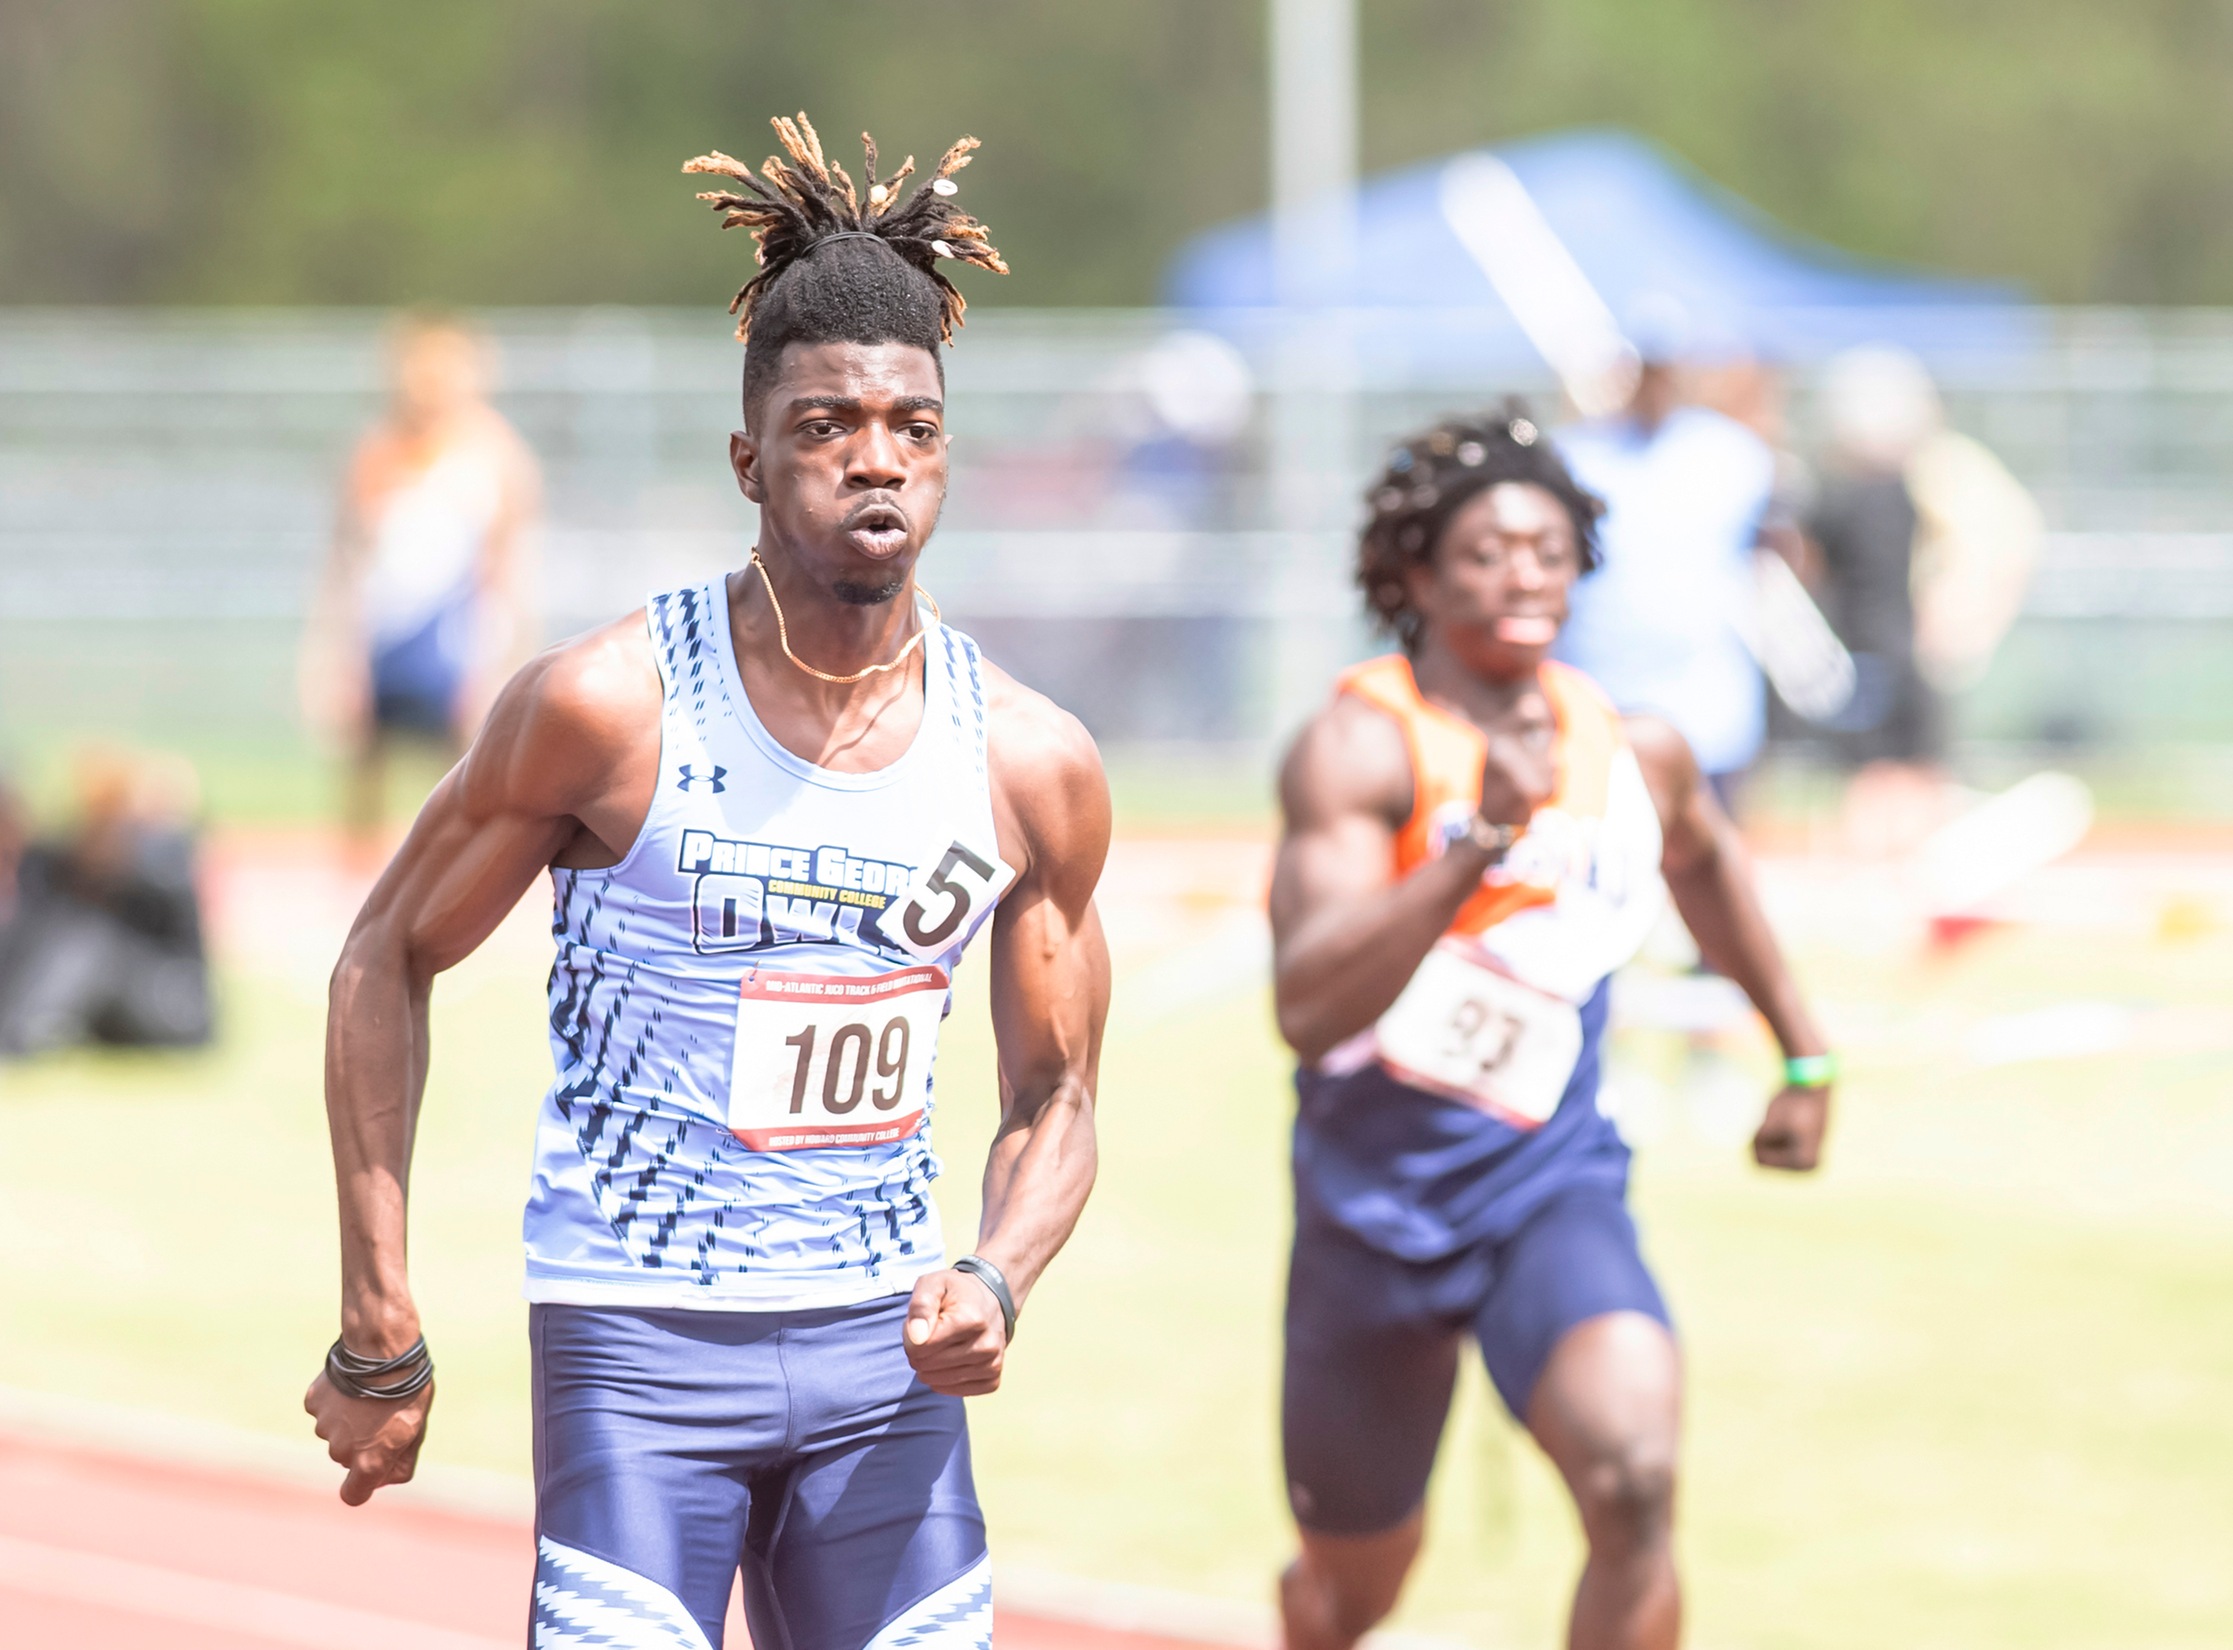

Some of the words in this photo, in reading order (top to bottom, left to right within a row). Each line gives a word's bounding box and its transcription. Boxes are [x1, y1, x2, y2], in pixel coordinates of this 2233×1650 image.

[678, 829, 812, 883] PRINCE
[815, 845, 917, 898] GEOR
[768, 880, 838, 903] COMMUNITY
[838, 889, 887, 910] COLLEGE
[902, 840, 996, 947] 5
[693, 874, 905, 960] OWL
[824, 984, 845, 996] JUCO
[845, 984, 871, 996] TRACK
[785, 1015, 910, 1115] 109
[768, 1135, 795, 1147] HOSTED
[795, 1135, 805, 1146] BY
[835, 1132, 876, 1144] COMMUNITY
[875, 1127, 900, 1141] COLLEGE
